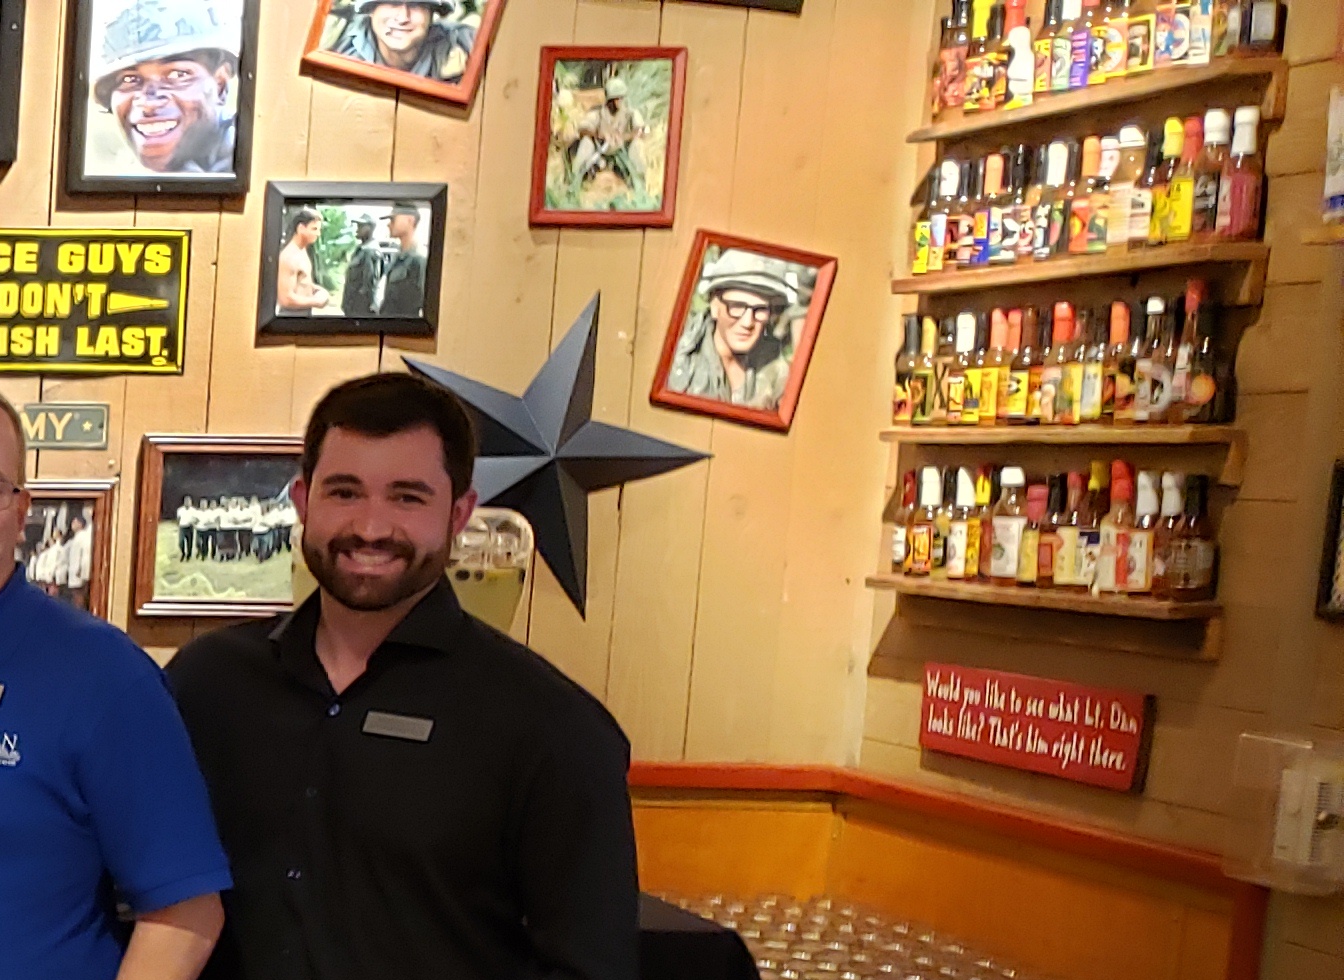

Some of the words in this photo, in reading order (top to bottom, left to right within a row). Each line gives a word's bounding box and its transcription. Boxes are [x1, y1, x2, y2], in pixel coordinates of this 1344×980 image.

[57, 243, 172, 275] GUYS
[75, 325, 169, 357] LAST.
[20, 411, 73, 441] MY
[926, 669, 962, 703] Would
[960, 687, 981, 712] you
[984, 678, 1006, 712] like
[1009, 687, 1022, 714] to
[1025, 695, 1045, 718] see
[1048, 691, 1080, 725] what
[1084, 696, 1105, 729] Lt.
[1109, 701, 1138, 735] Dan
[927, 702, 954, 736] looks
[957, 707, 986, 742] like?
[989, 715, 1023, 751] That's
[1025, 722, 1049, 755] him
[1052, 731, 1085, 770] right
[1088, 735, 1127, 771] there.
